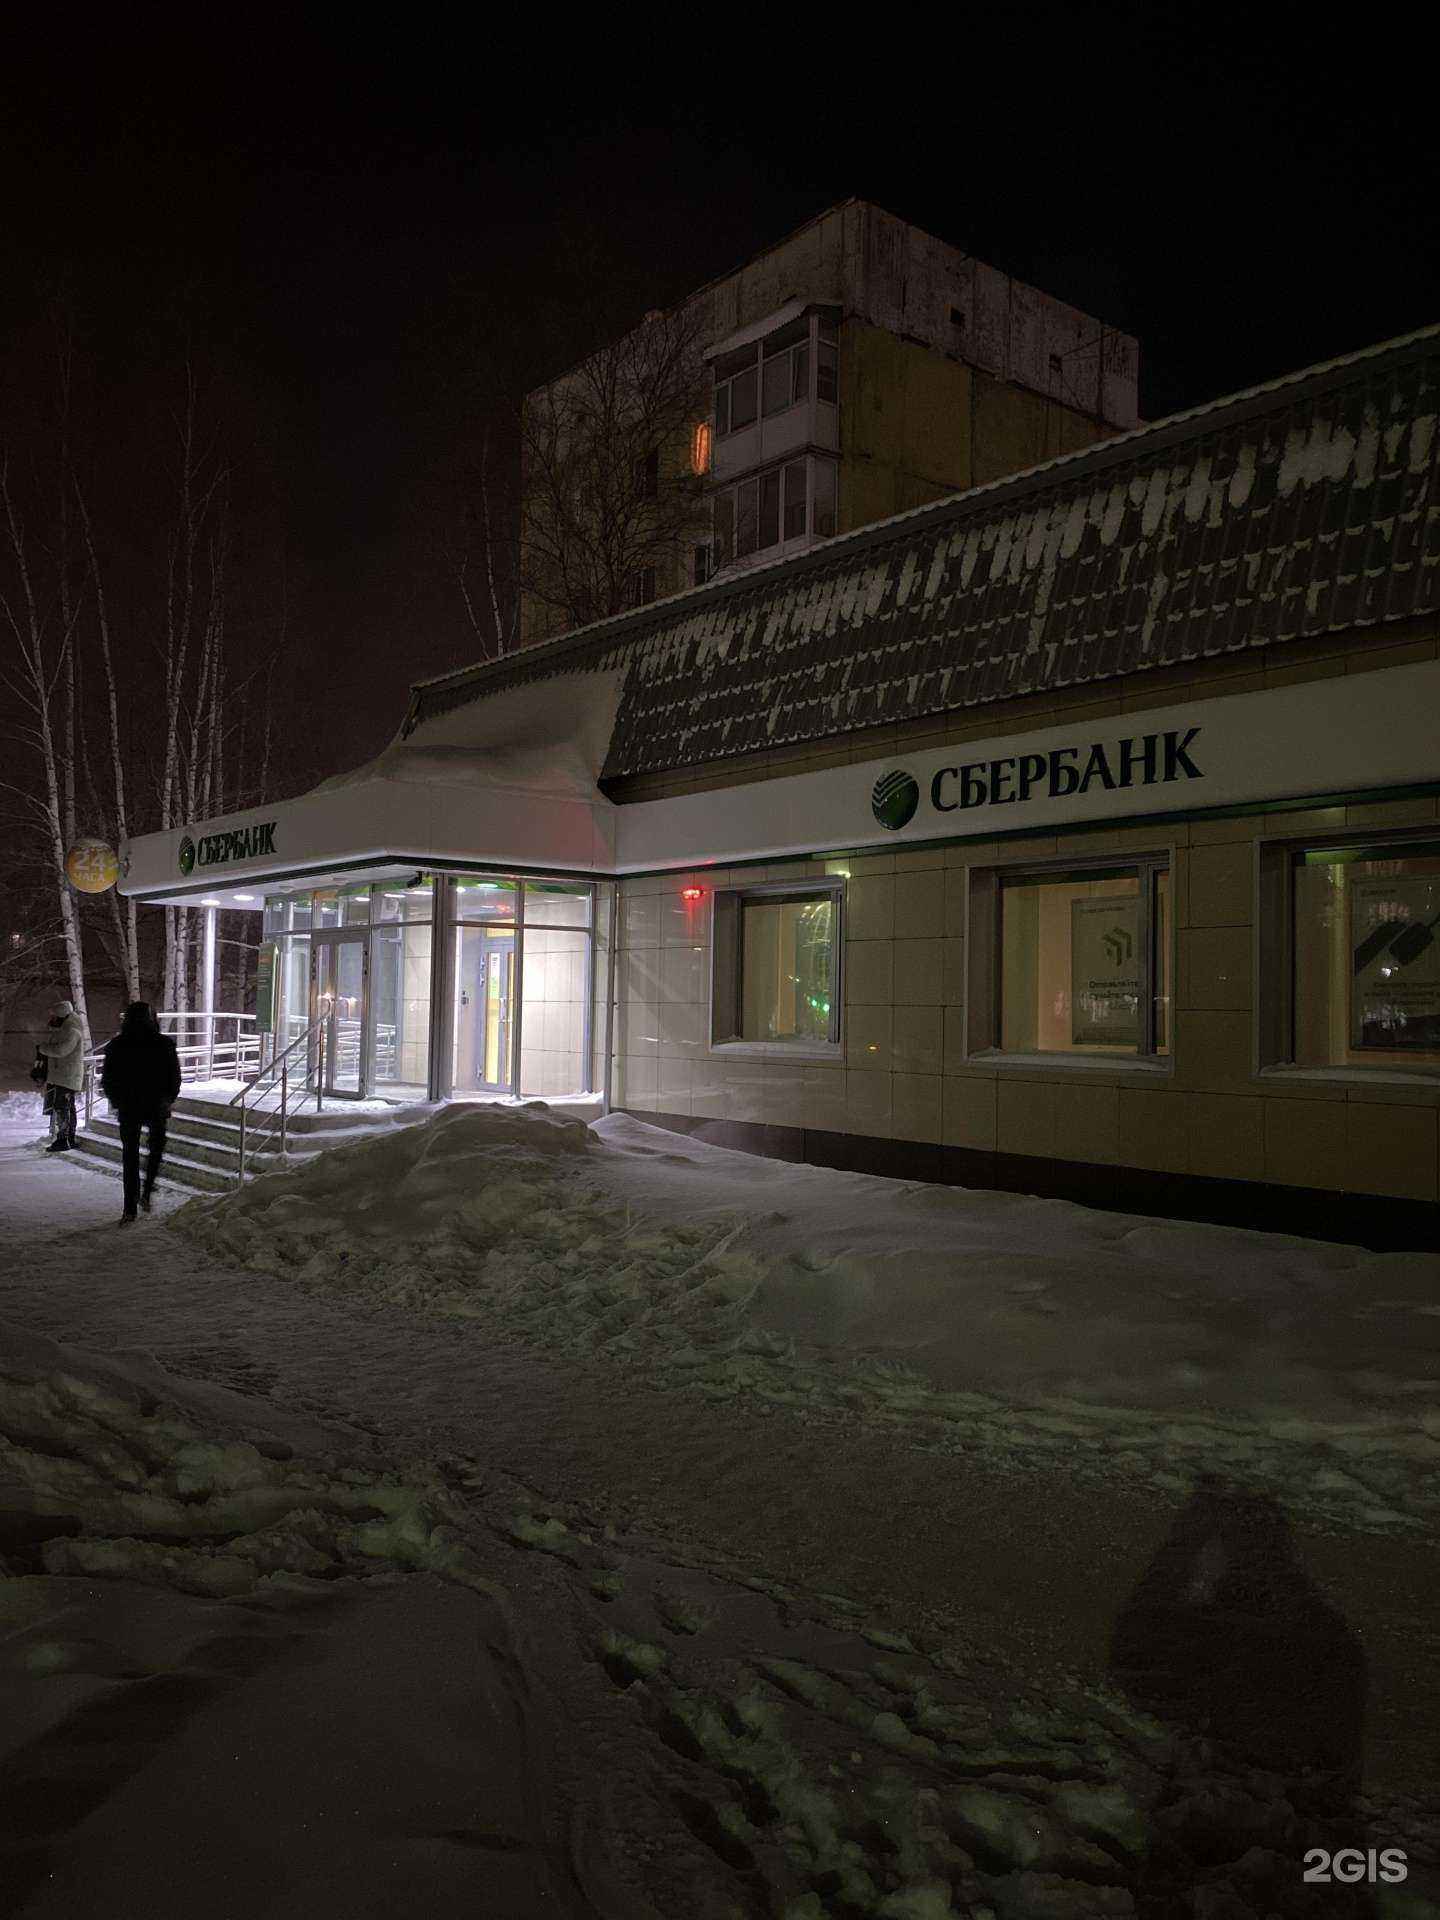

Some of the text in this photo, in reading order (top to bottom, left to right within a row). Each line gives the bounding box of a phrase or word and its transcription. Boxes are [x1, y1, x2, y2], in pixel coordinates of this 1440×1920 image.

[930, 727, 1206, 813] СБЕРБАНК
[75, 848, 105, 871] 24
[197, 822, 278, 867] СБЕРБАНК
[73, 871, 105, 882] ЧАСА
